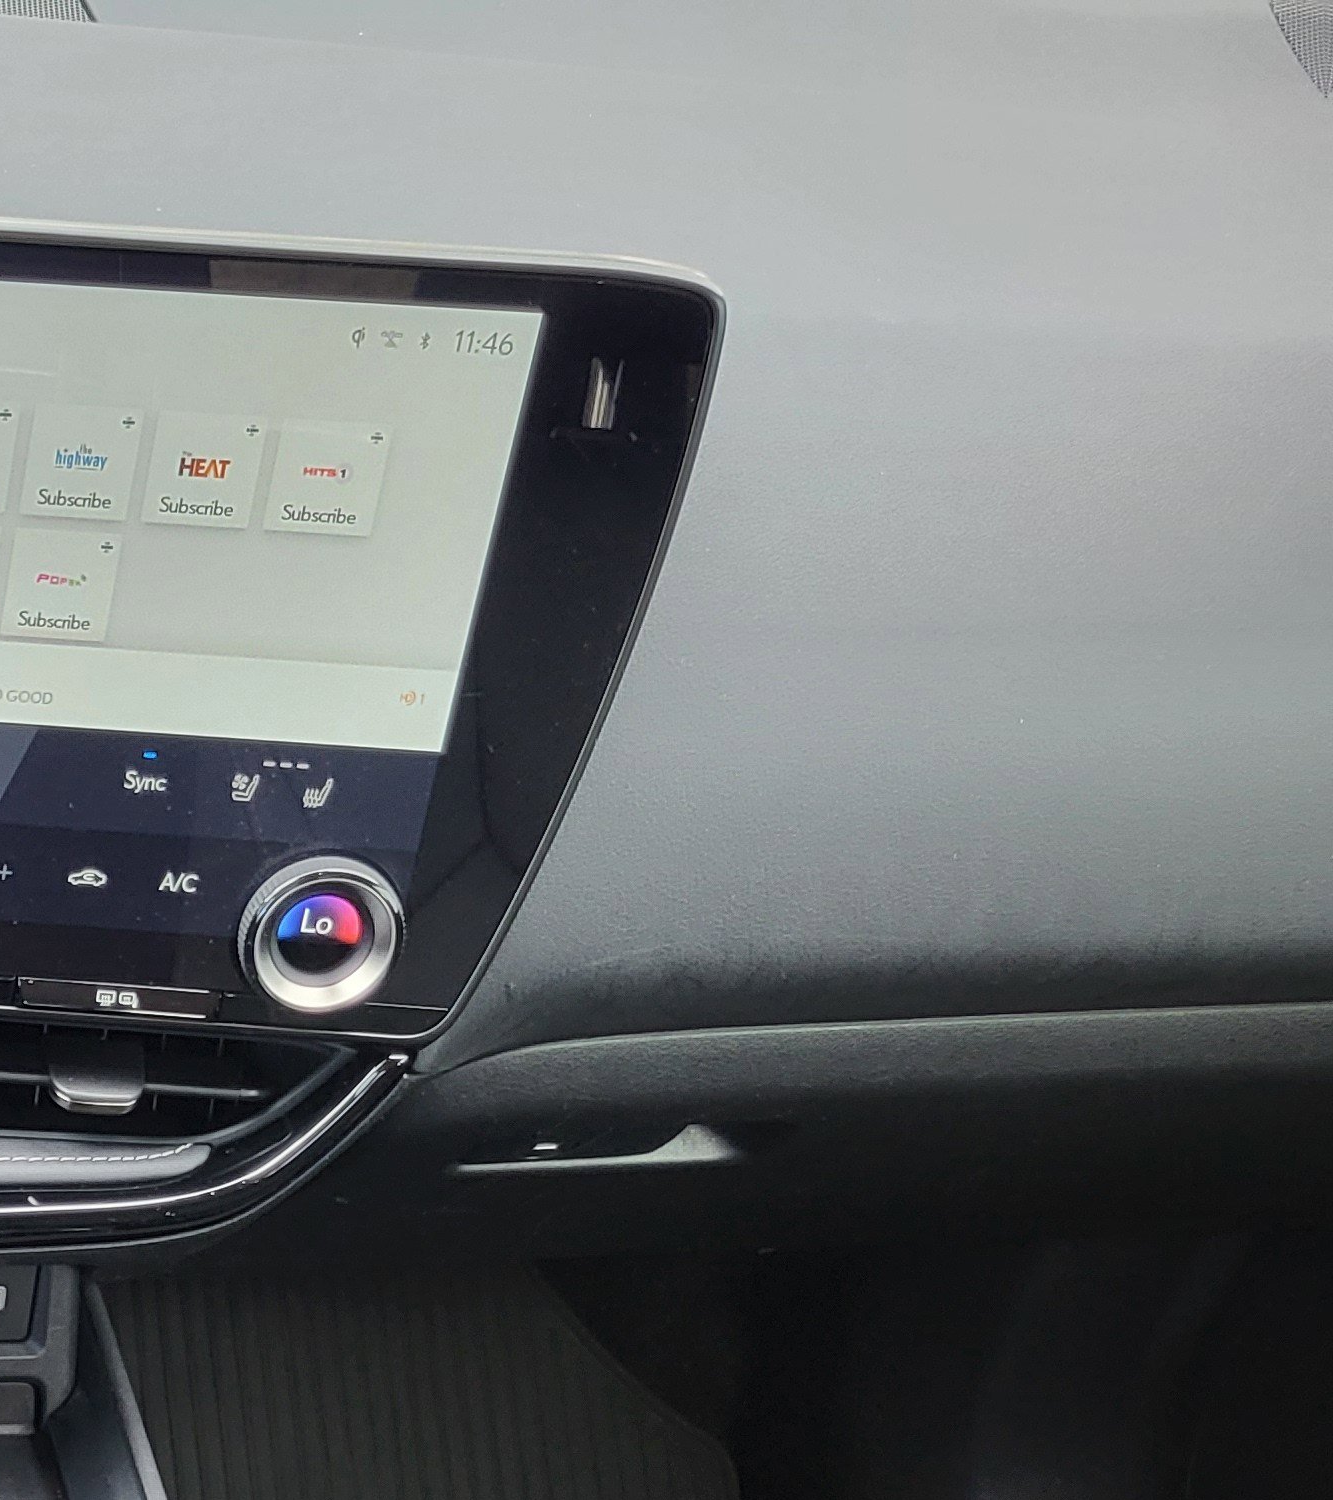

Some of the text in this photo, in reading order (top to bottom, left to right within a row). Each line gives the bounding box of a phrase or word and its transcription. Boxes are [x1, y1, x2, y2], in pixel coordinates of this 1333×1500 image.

[455, 330, 514, 356] 11:46
[54, 449, 109, 472] highway
[178, 457, 231, 479] HEAT
[303, 466, 337, 478] HITS
[37, 488, 112, 510] Subscribe
[159, 496, 234, 518] Subscribe
[281, 504, 357, 526] Subscribe
[17, 610, 91, 631] Subscribe
[6, 690, 54, 706] GOOD
[123, 771, 167, 793] Sync
[158, 871, 200, 894] A/C
[300, 909, 333, 935] Lo
